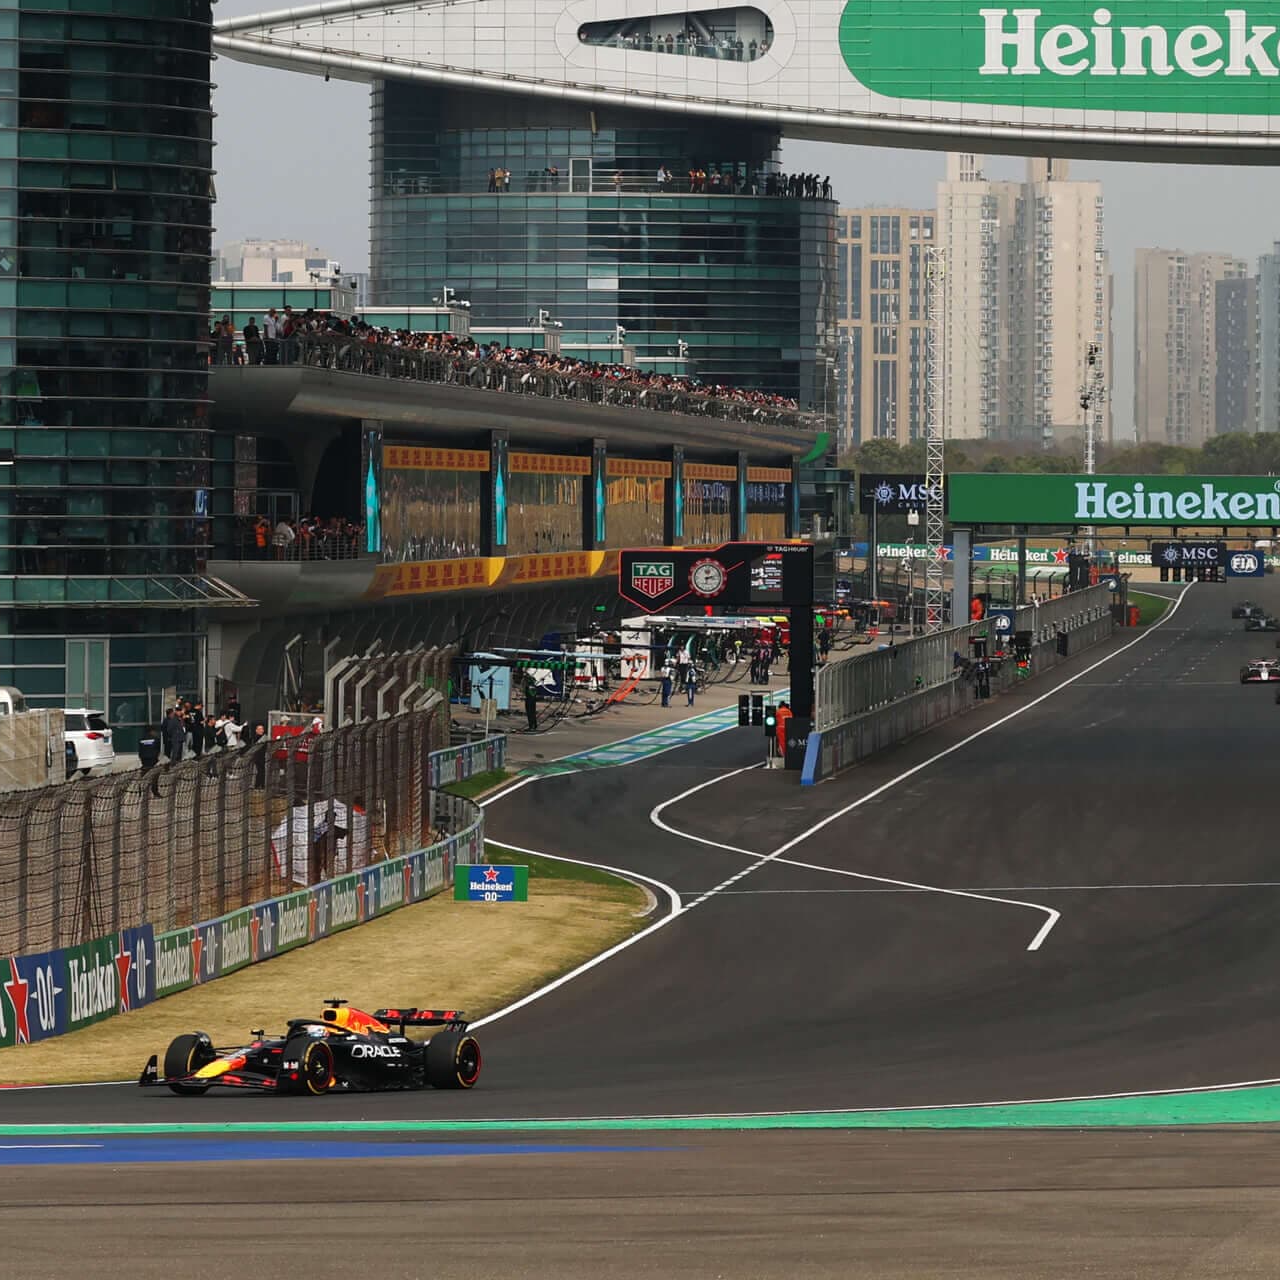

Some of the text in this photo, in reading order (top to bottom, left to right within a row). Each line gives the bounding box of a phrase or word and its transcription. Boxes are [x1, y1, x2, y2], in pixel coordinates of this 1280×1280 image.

[990, 548, 1048, 562] Heinken
[1182, 548, 1218, 559] MSC
[635, 564, 671, 576] TAG
[1232, 556, 1257, 570] FIA
[634, 577, 672, 597] HEUER
[470, 881, 512, 891] Heineken
[351, 1044, 402, 1058] ORACLE
